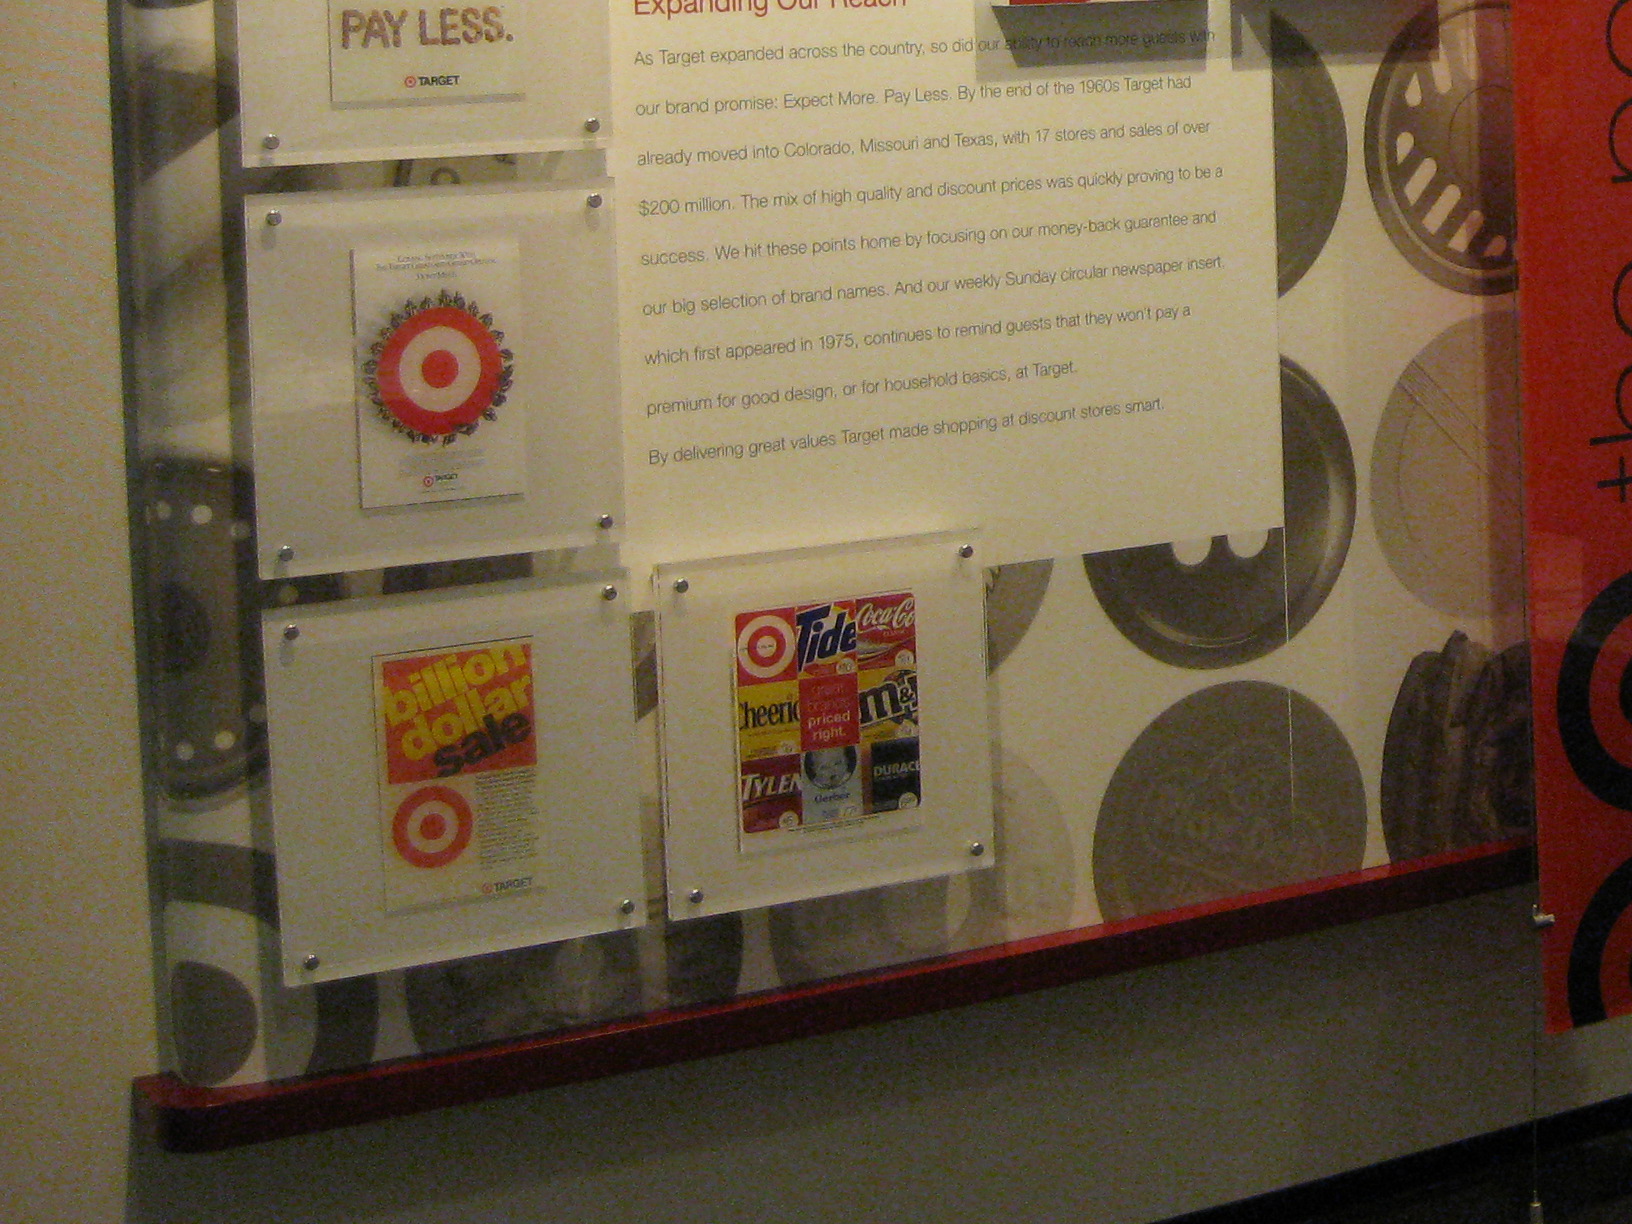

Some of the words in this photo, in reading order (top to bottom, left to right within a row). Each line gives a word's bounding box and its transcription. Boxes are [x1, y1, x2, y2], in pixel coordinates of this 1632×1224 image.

[340, 8, 408, 50] PAY
[418, 6, 514, 46] LESS.
[418, 75, 460, 86] TARGET
[635, 104, 660, 116] our
[665, 99, 709, 114] brand
[714, 96, 777, 115] promise:
[783, 93, 833, 112] Expect
[838, 91, 879, 106] More.
[884, 90, 910, 107] Pay
[914, 88, 952, 102] Less.
[957, 86, 975, 104] By
[980, 85, 1001, 99] the
[1006, 84, 1032, 98] end
[1036, 83, 1048, 96] of
[1054, 82, 1074, 96] the
[1081, 79, 1119, 94] 1960s
[1126, 77, 1163, 95] Target
[1167, 75, 1191, 90] had
[637, 149, 692, 169] already
[696, 146, 748, 162] moved
[752, 145, 779, 159] into
[784, 140, 854, 158] Colorado,
[860, 137, 919, 153] Missouri
[923, 135, 950, 150] and
[954, 132, 997, 149] Texas,
[1002, 131, 1030, 145] with
[1036, 130, 1049, 143] 17
[1054, 128, 1096, 142] stores
[1100, 125, 1125, 140] and
[1129, 123, 1162, 138] sales
[1166, 122, 1178, 136] of
[1182, 123, 1209, 134] over
[638, 200, 680, 219] $200
[741, 194, 768, 209] The
[773, 193, 798, 207] mix
[802, 191, 816, 205] of
[820, 188, 852, 207] high
[856, 185, 902, 204] quality
[906, 183, 933, 198] and
[937, 179, 996, 196] discount
[1000, 176, 1042, 195] prices
[1046, 177, 1073, 188] was
[1077, 170, 1122, 189] quickly
[1126, 167, 1174, 186] proving
[1178, 166, 1190, 179] to
[1194, 164, 1211, 178] be
[1215, 166, 1223, 176] a
[642, 304, 666, 316] our
[672, 298, 696, 316] big
[700, 293, 766, 311] selection
[771, 291, 785, 305] of
[790, 288, 832, 304] brand
[894, 280, 923, 296] And
[926, 282, 949, 293] our
[954, 274, 1000, 294] weekly
[1005, 270, 1056, 290] Sunday
[1060, 266, 1106, 282] circular
[1112, 263, 1182, 281] newspaper
[646, 395, 712, 417] premium
[717, 393, 735, 407] for
[741, 389, 780, 408] good
[842, 385, 856, 396] or
[861, 380, 879, 394] for
[884, 372, 958, 392] household
[962, 368, 1010, 386] basics,
[1015, 366, 1028, 380] at
[648, 449, 668, 468] By
[672, 441, 744, 465] delivering
[748, 438, 785, 457] great
[790, 432, 836, 449] values
[841, 427, 884, 447] Target
[889, 422, 928, 439] made
[933, 415, 997, 438] shopping
[1001, 414, 1014, 427] at
[1018, 406, 1076, 425] discount
[1080, 402, 1120, 418] stores
[797, 604, 857, 672] Tide
[382, 646, 527, 727] billion
[402, 674, 532, 760] dollar
[808, 710, 850, 729] priced
[434, 712, 532, 777] sale
[814, 792, 850, 804] Gerber
[494, 876, 533, 893] TARGET
